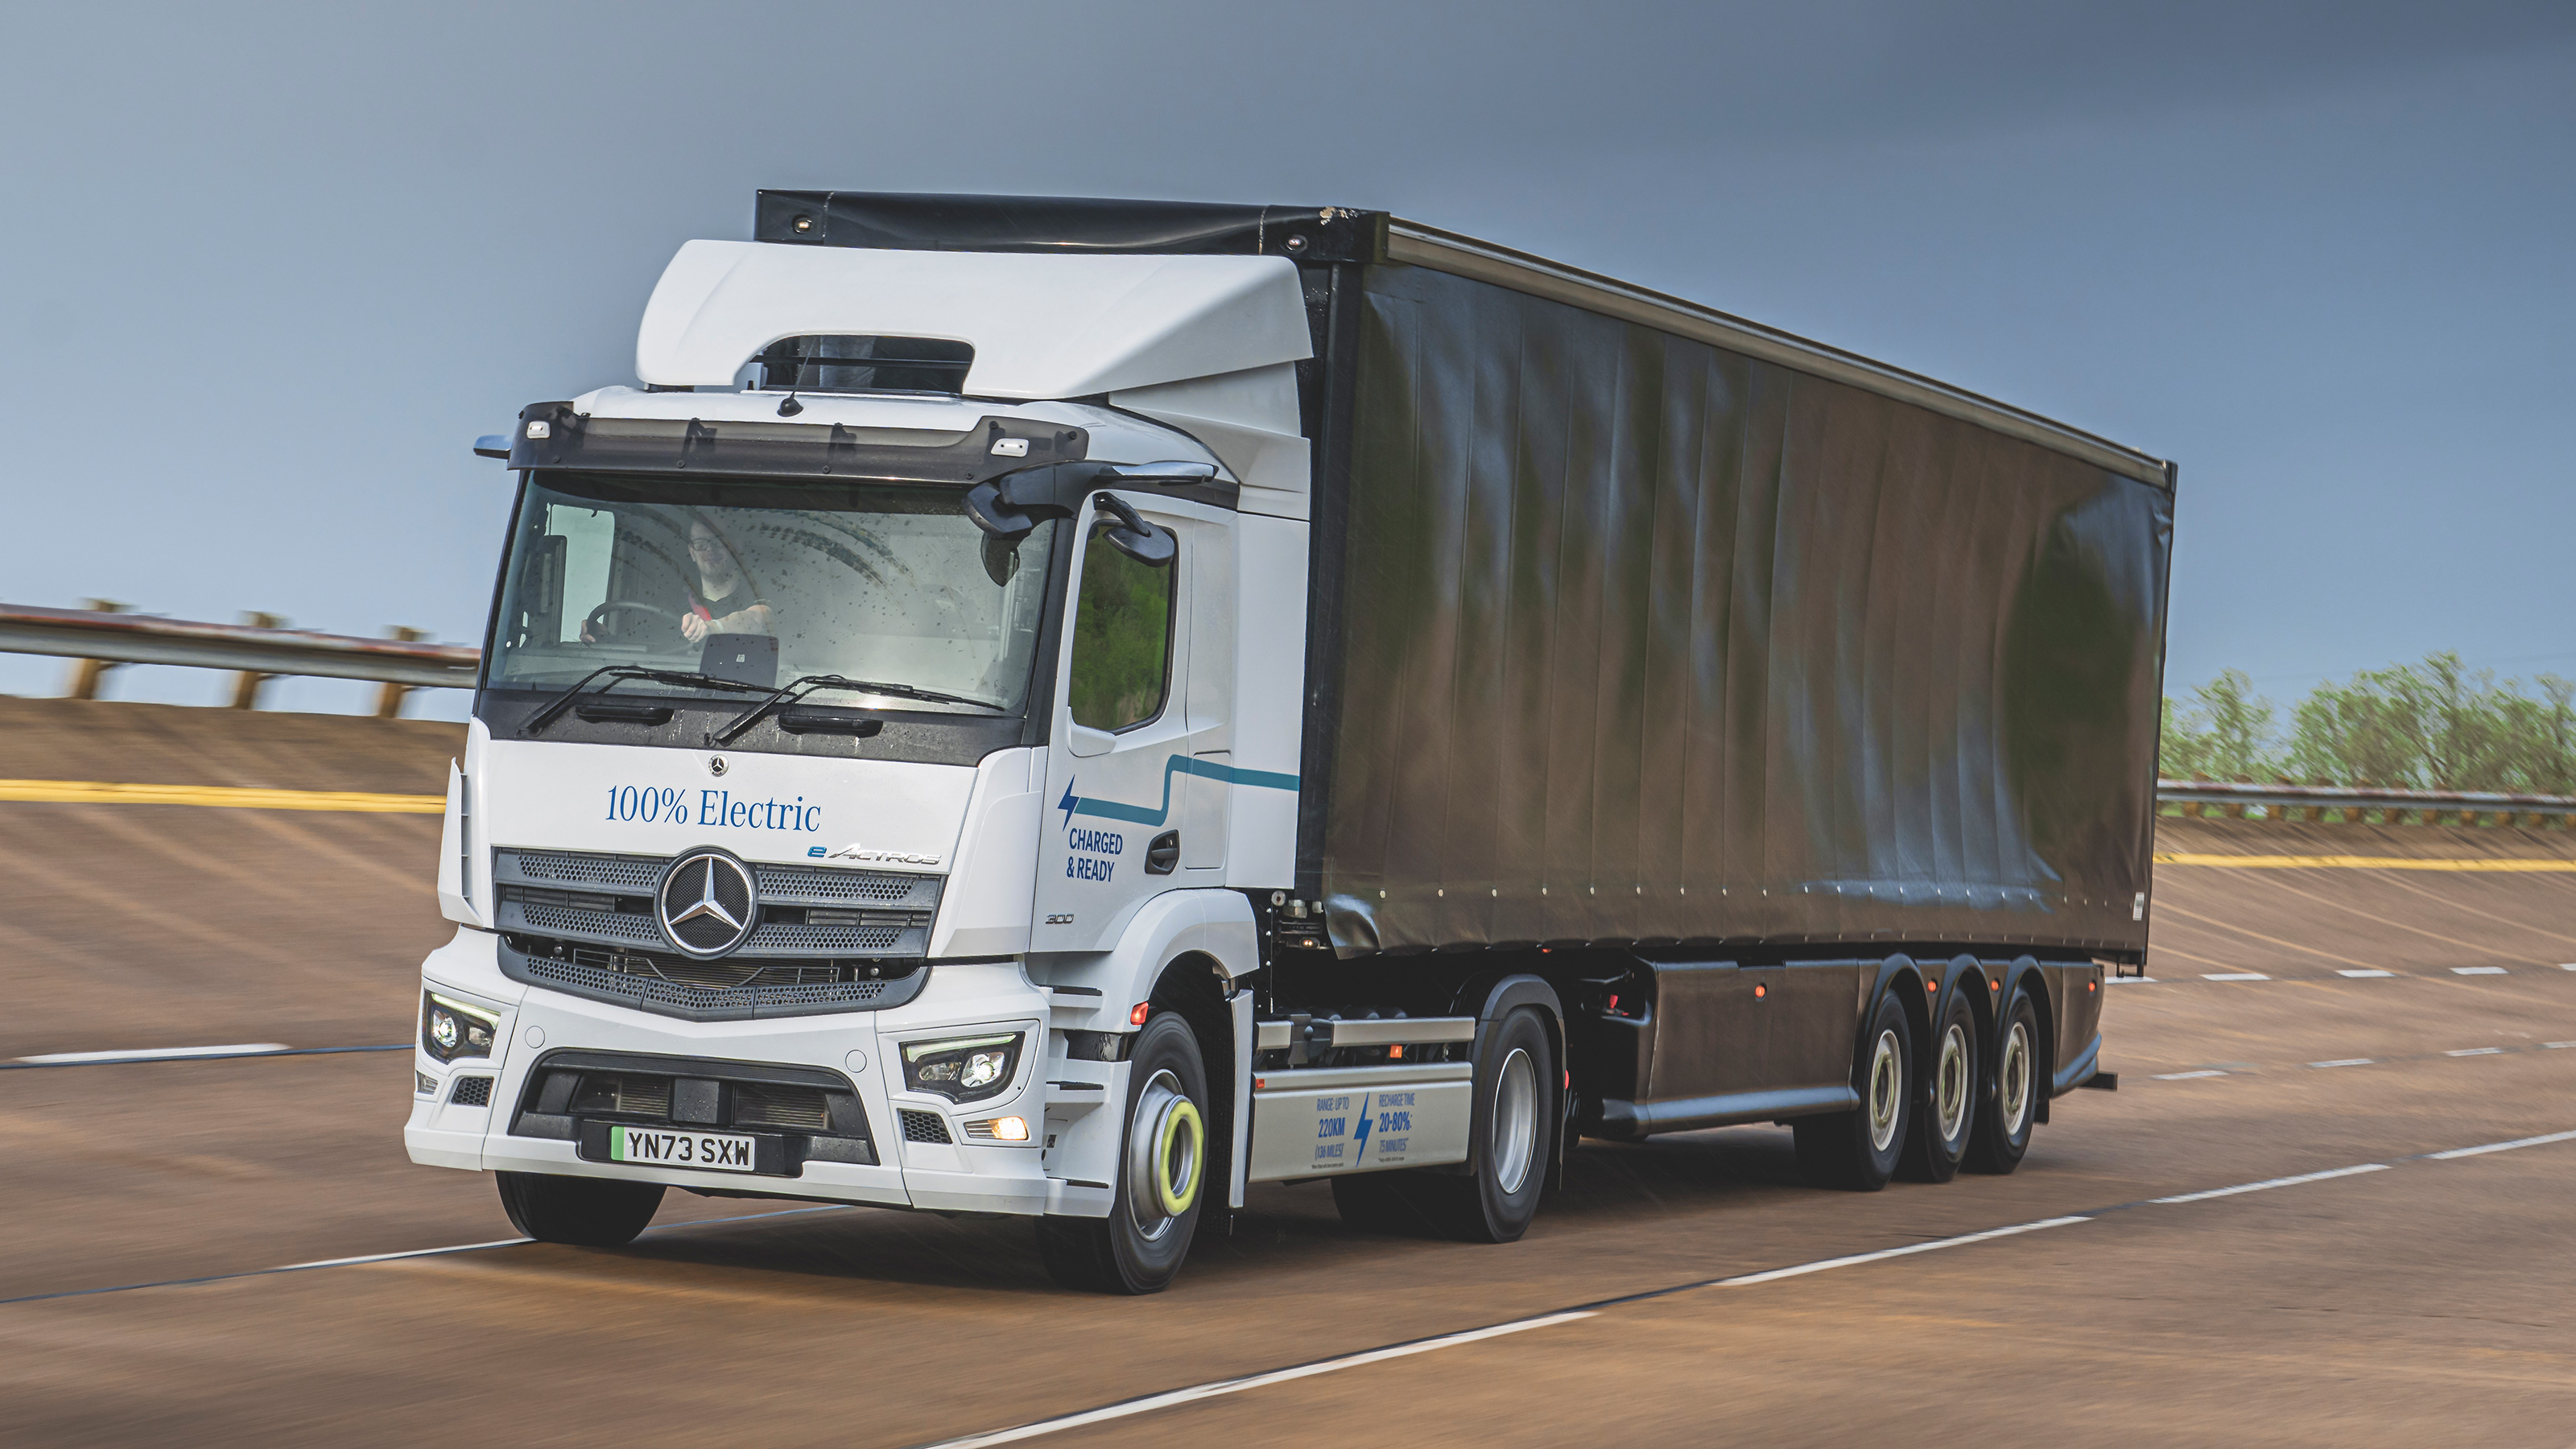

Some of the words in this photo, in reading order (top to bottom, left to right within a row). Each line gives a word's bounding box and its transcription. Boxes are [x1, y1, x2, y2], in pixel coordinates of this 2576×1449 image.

[605, 784, 688, 824] 100%
[697, 789, 821, 832] Electric
[1069, 828, 1123, 855] CHARGED
[1066, 856, 1075, 878] &
[1076, 857, 1115, 882] READY
[1335, 1096, 1342, 1110] UP
[1342, 1096, 1349, 1109] TO
[1379, 1093, 1403, 1108] RECHARGE
[1404, 1092, 1415, 1106] TIME
[1318, 1117, 1346, 1138] 220KM
[1379, 1111, 1413, 1133] 20-80%:
[628, 1132, 693, 1161] YN73
[700, 1137, 749, 1166] SXW
[1315, 1144, 1327, 1162] (136
